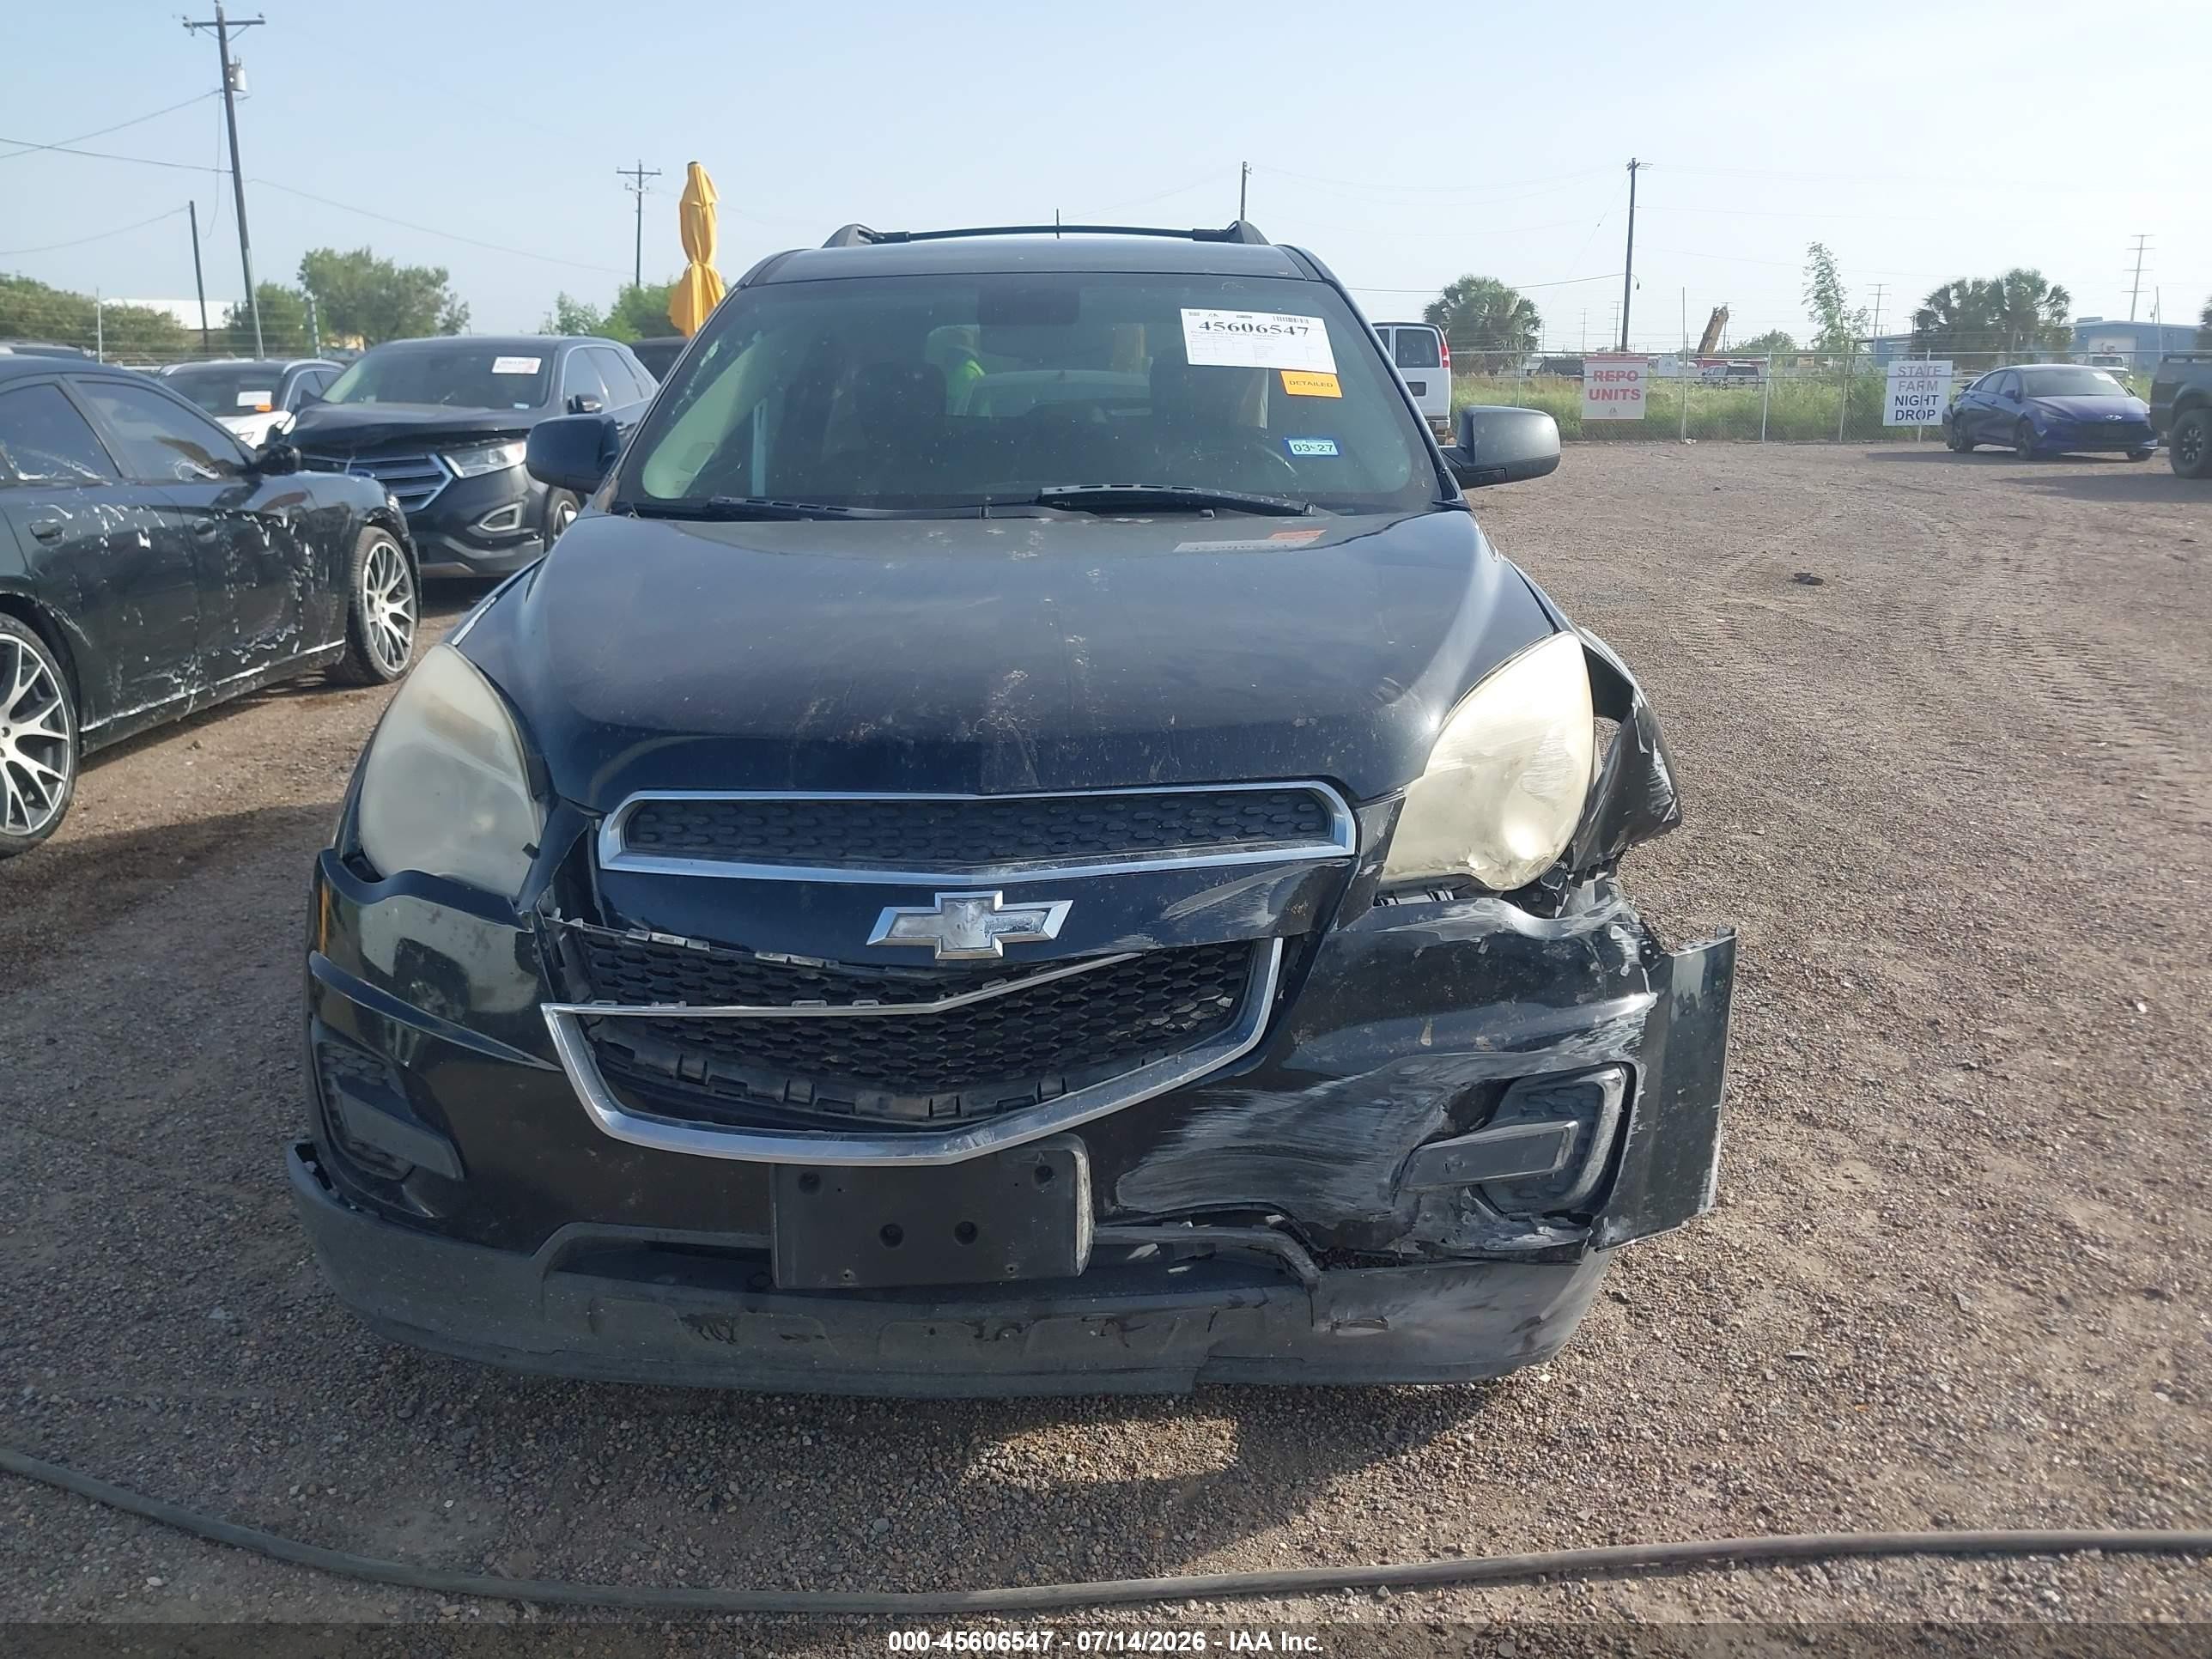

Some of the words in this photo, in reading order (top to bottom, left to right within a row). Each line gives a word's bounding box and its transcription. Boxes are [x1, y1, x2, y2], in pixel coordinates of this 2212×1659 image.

[1198, 320, 1310, 337] 45606547
[1593, 370, 1639, 383] REPO
[1898, 365, 1942, 377] STATE
[1289, 380, 1334, 388] DETAILED
[1898, 380, 1938, 392] FARM
[1589, 388, 1642, 401] UNITS
[1894, 394, 1941, 406] NIGHT
[1895, 409, 1936, 421] DROP
